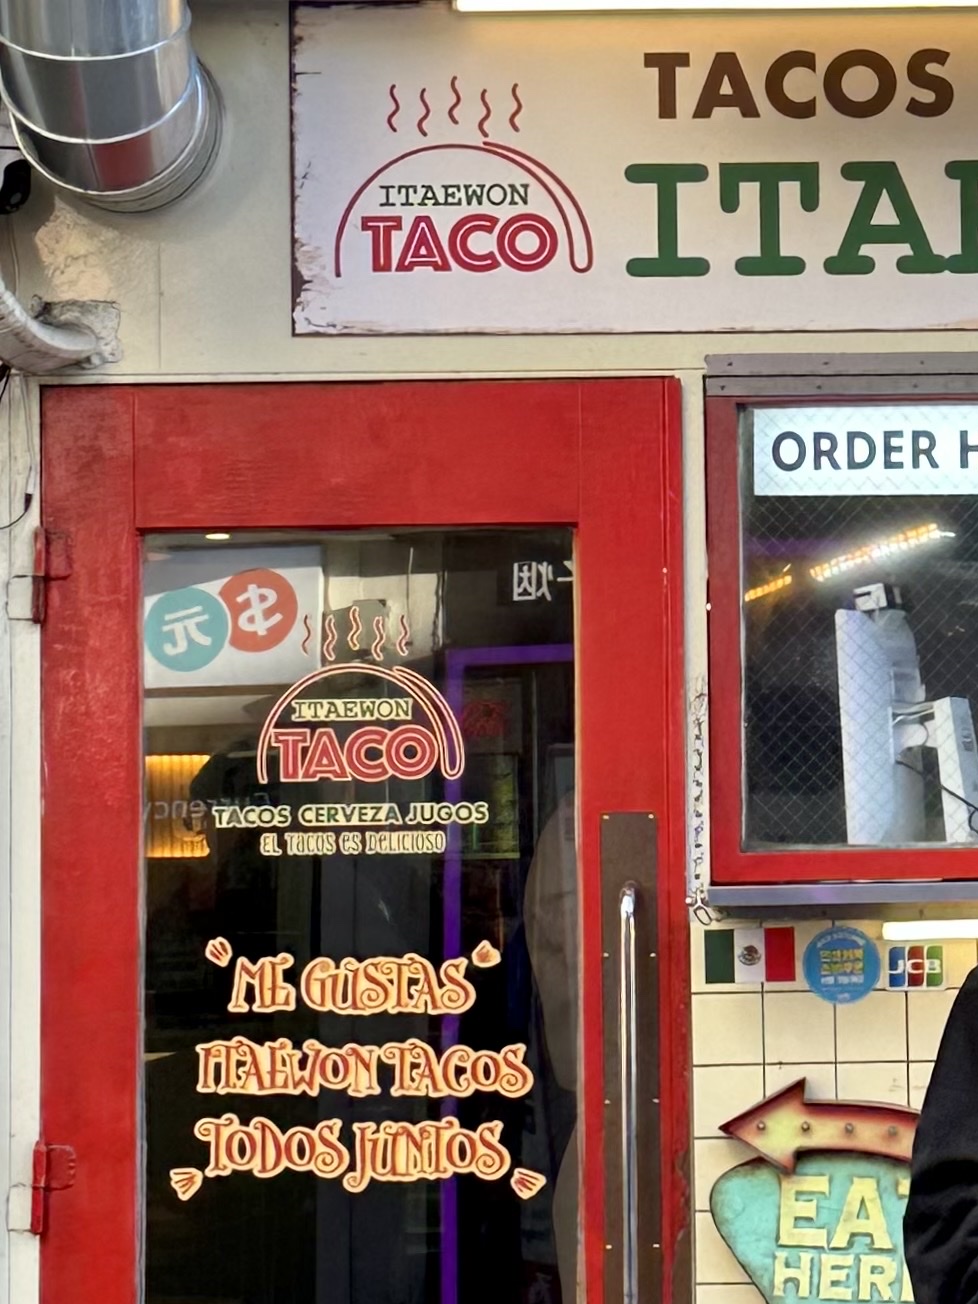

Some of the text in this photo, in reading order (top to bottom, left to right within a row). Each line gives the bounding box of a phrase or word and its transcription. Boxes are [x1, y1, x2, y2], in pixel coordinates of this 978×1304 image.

[644, 48, 954, 119] TACOS
[379, 183, 530, 208] ITAEWON
[361, 213, 558, 273] TACO
[771, 428, 939, 472] ORDER
[292, 698, 412, 722] ITAEWON
[271, 724, 439, 782] TACO
[212, 801, 488, 828] TACOS CERVEZA JUGOS
[228, 953, 476, 1015] ME GUSTAS
[888, 958, 942, 974] JCB
[196, 1036, 534, 1098] ITAEWON TACOS
[195, 1113, 511, 1192] TODOS JUNTOS
[777, 1174, 911, 1250] EA
[773, 1251, 914, 1302] HER
